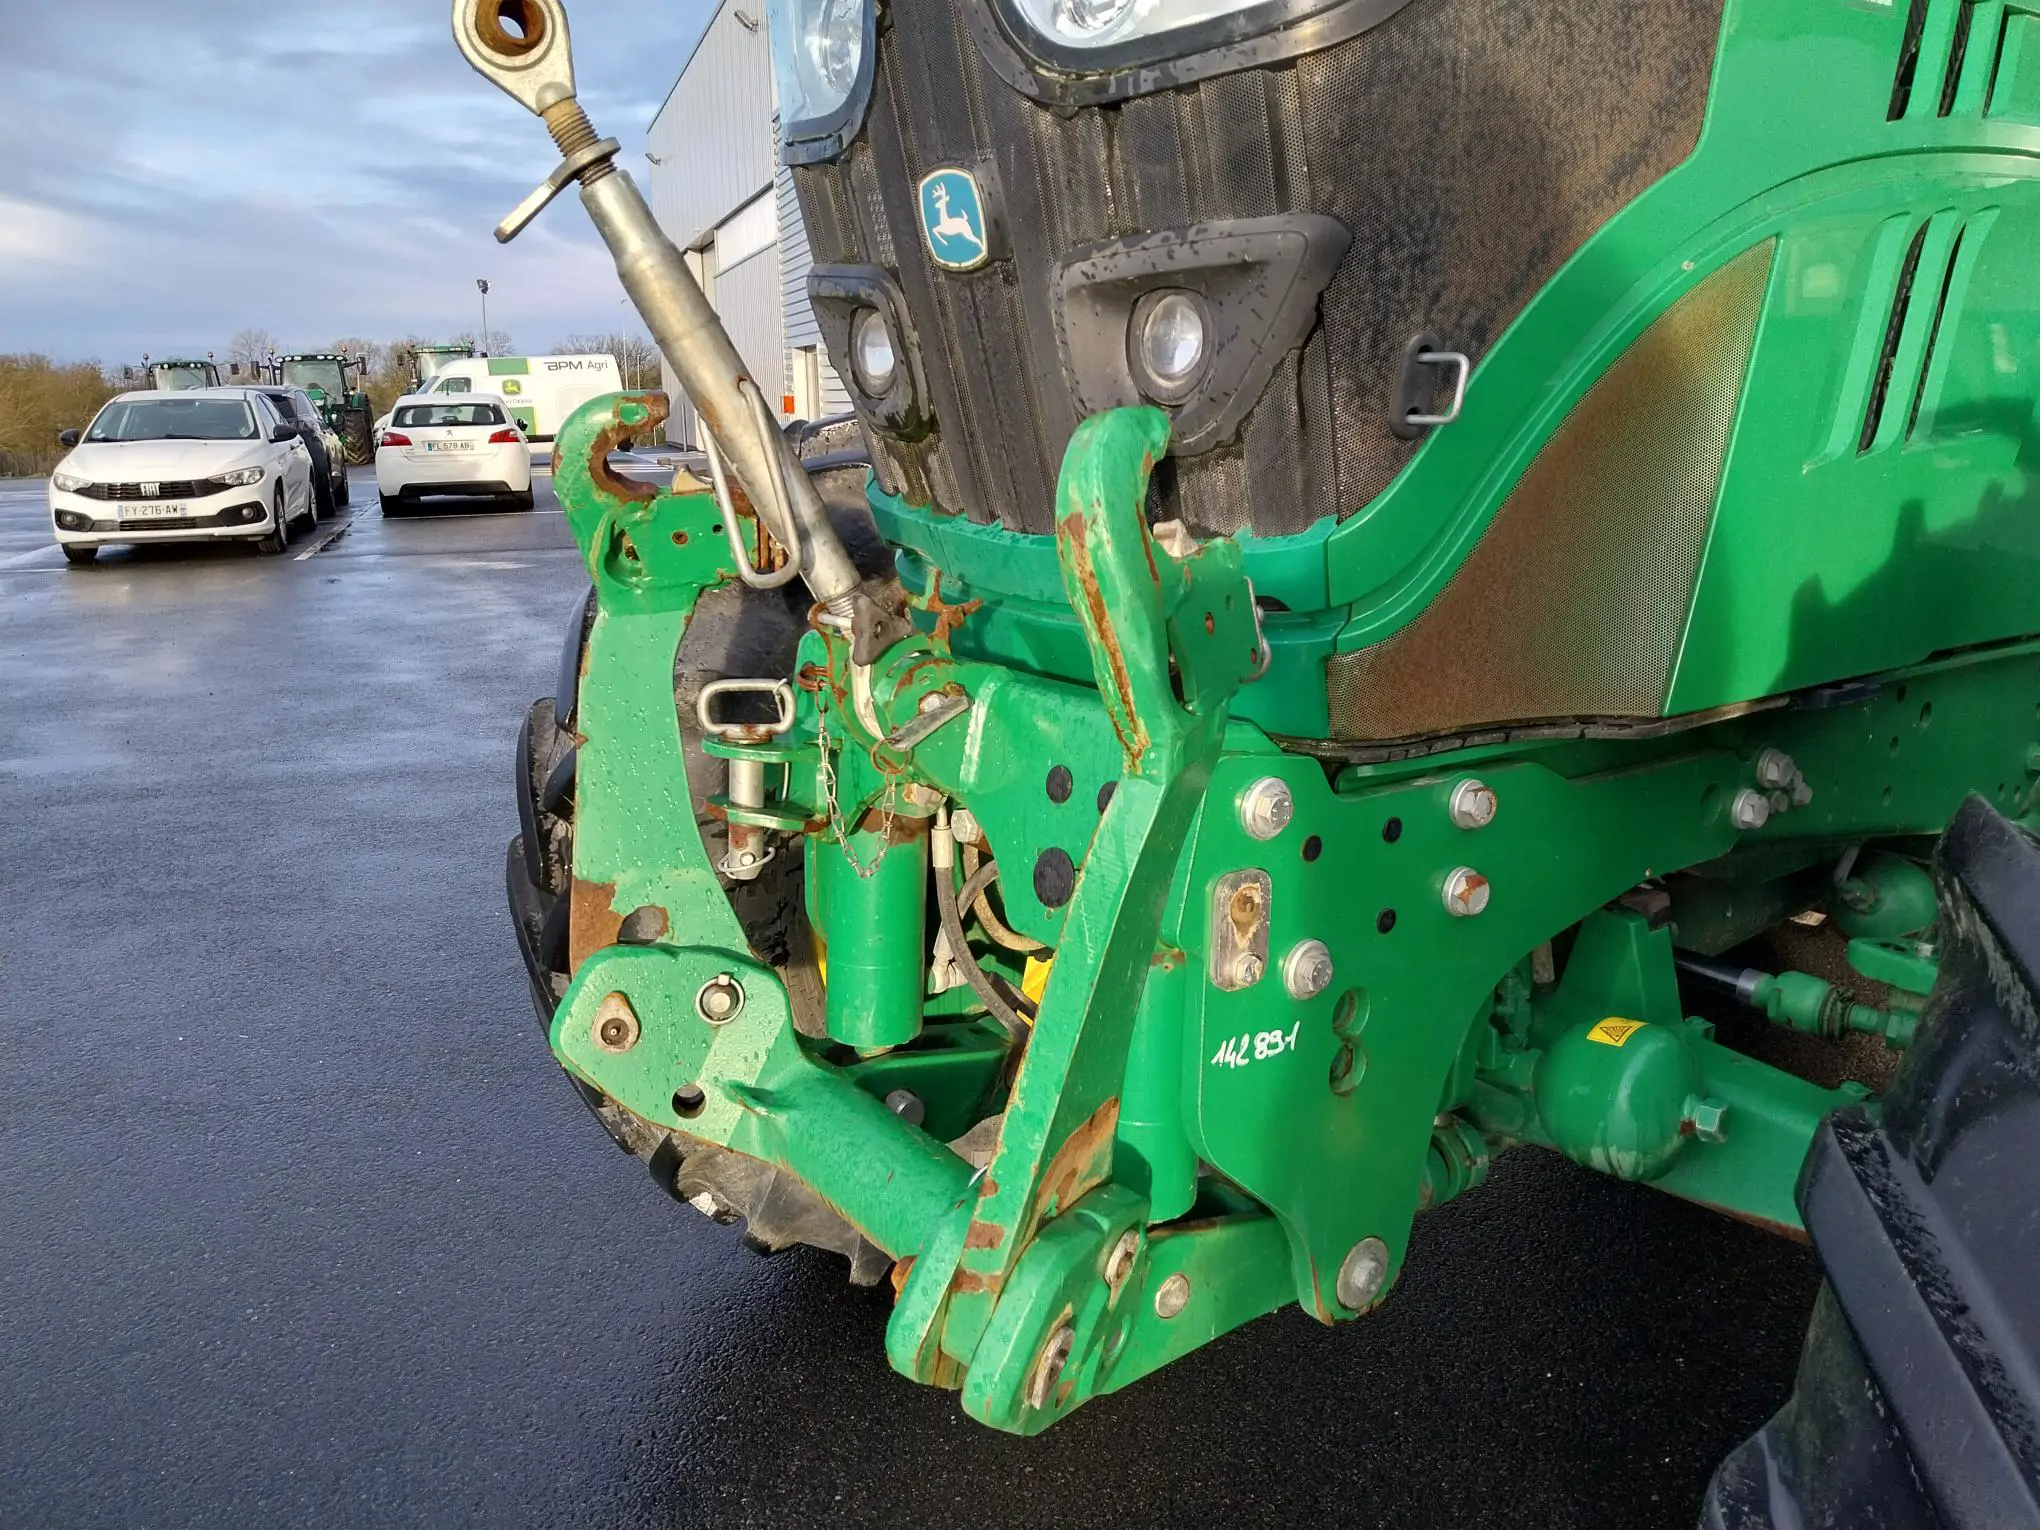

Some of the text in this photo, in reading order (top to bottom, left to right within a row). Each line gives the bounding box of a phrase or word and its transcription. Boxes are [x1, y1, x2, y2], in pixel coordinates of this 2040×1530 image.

[544, 360, 608, 372] BPM Agri
[140, 482, 160, 497] FIAT
